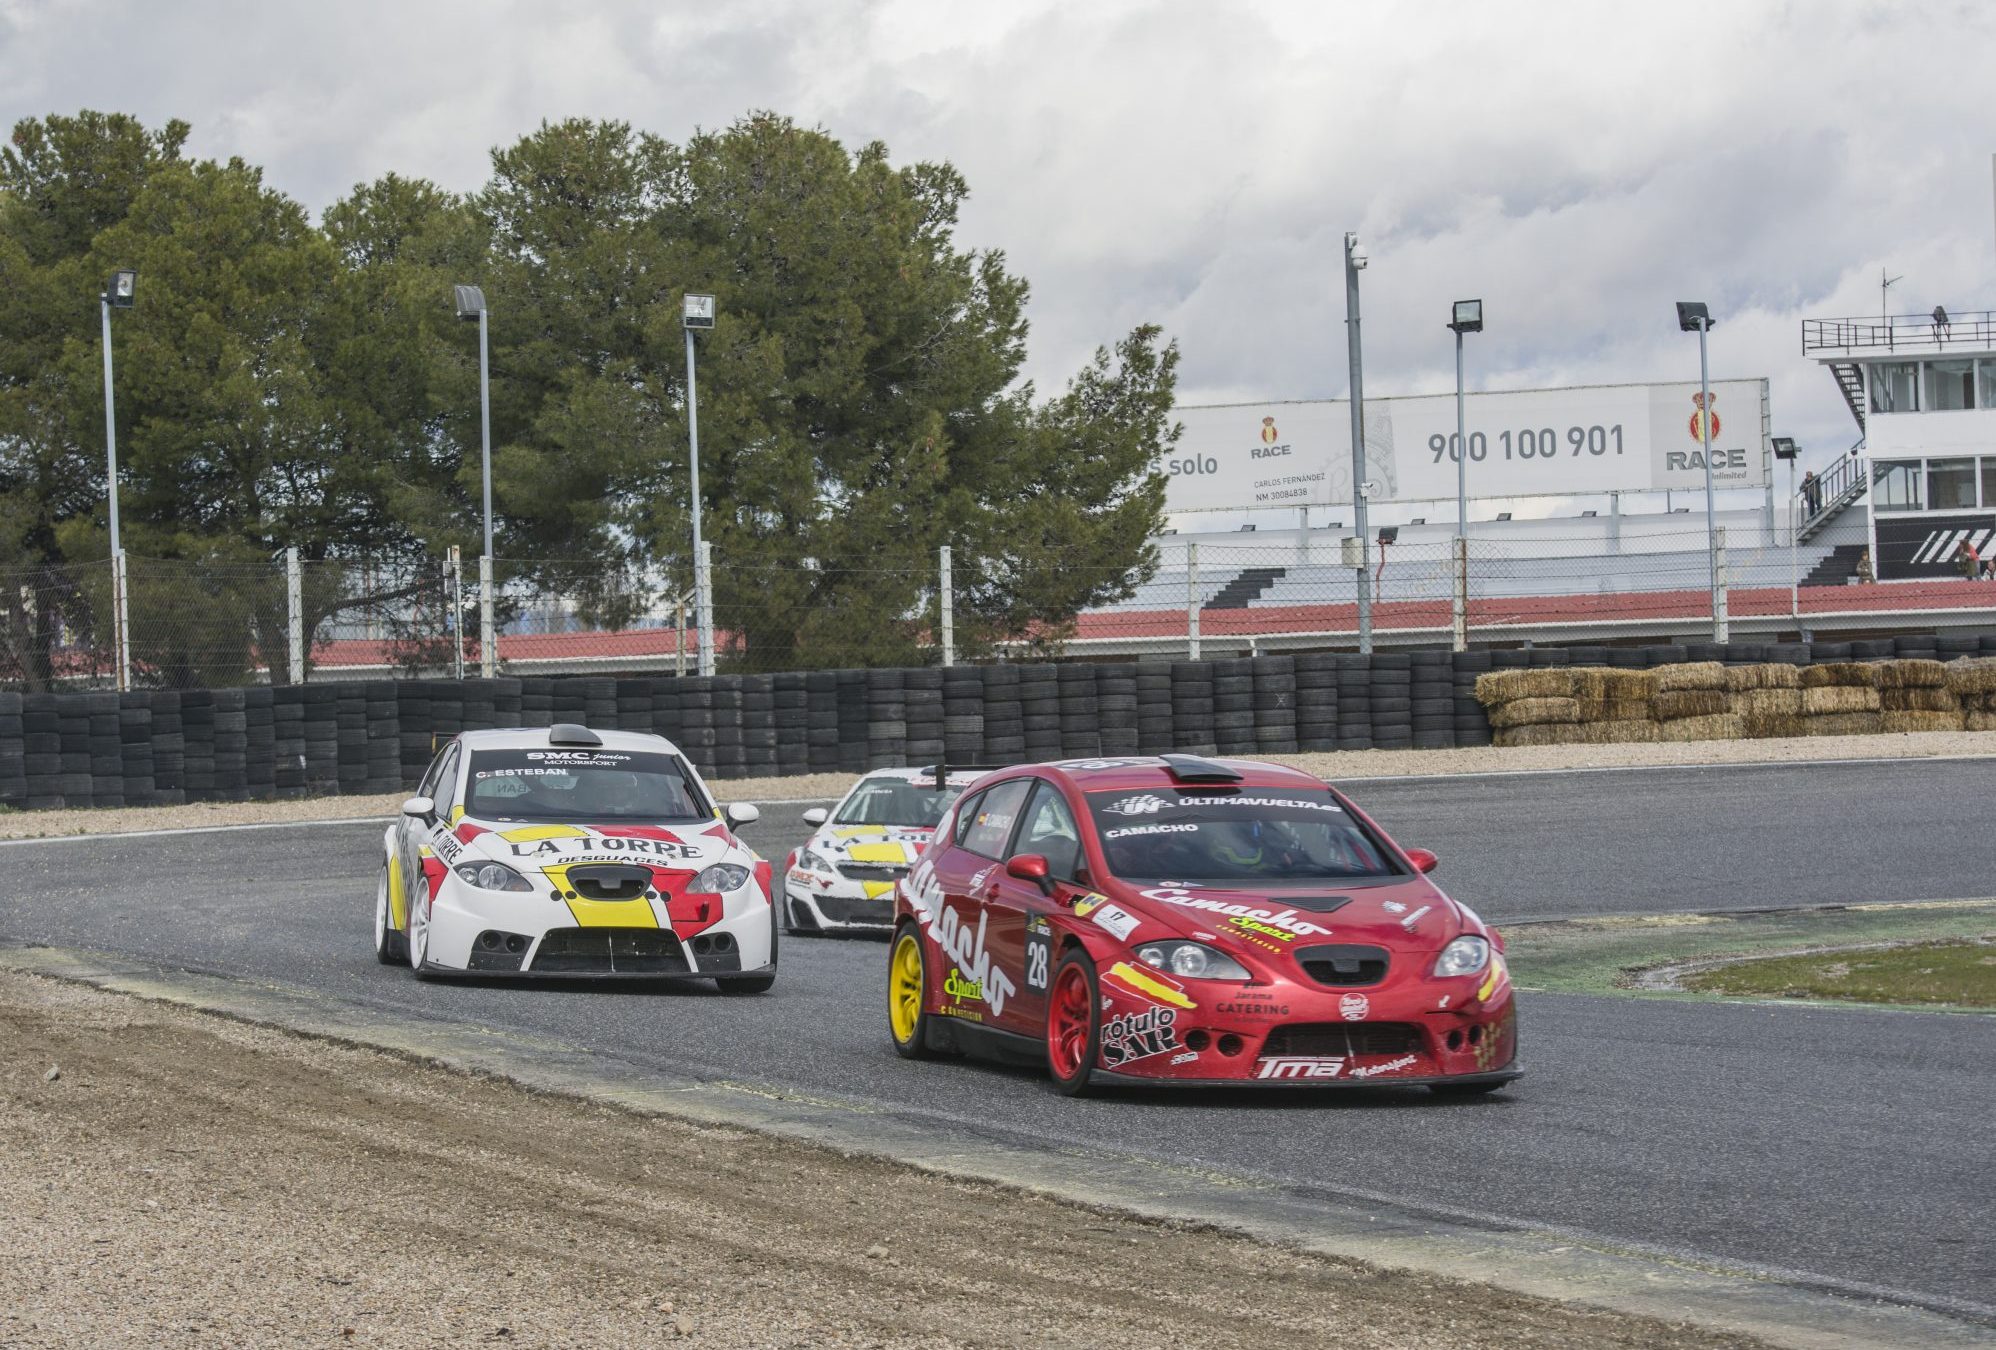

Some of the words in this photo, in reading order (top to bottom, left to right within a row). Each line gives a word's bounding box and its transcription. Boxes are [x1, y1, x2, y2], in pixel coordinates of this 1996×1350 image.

[1251, 445, 1291, 459] RACE
[1428, 431, 1487, 463] 900
[1499, 428, 1557, 459] 100
[1567, 424, 1623, 457] 901
[1169, 453, 1218, 475] solo
[1666, 449, 1746, 470] RACE
[1254, 479, 1281, 488] CARLOS
[1711, 471, 1747, 480] nlimited
[1256, 493, 1269, 501] NM
[1270, 488, 1307, 500] 30084838
[527, 752, 590, 760] SMC
[592, 753, 632, 761] junior
[1106, 823, 1199, 839] CAMACHO
[510, 840, 562, 857] LA
[574, 838, 704, 859] TORRE
[557, 855, 669, 866] DESGUACES
[1110, 911, 1127, 921] 17
[1139, 888, 1333, 935] Camacho
[1228, 917, 1297, 942] Sport
[1027, 941, 1048, 989] 28
[944, 968, 983, 1005] Sport
[1216, 1003, 1290, 1015] CATERING
[1349, 1054, 1418, 1079] Motorsport
